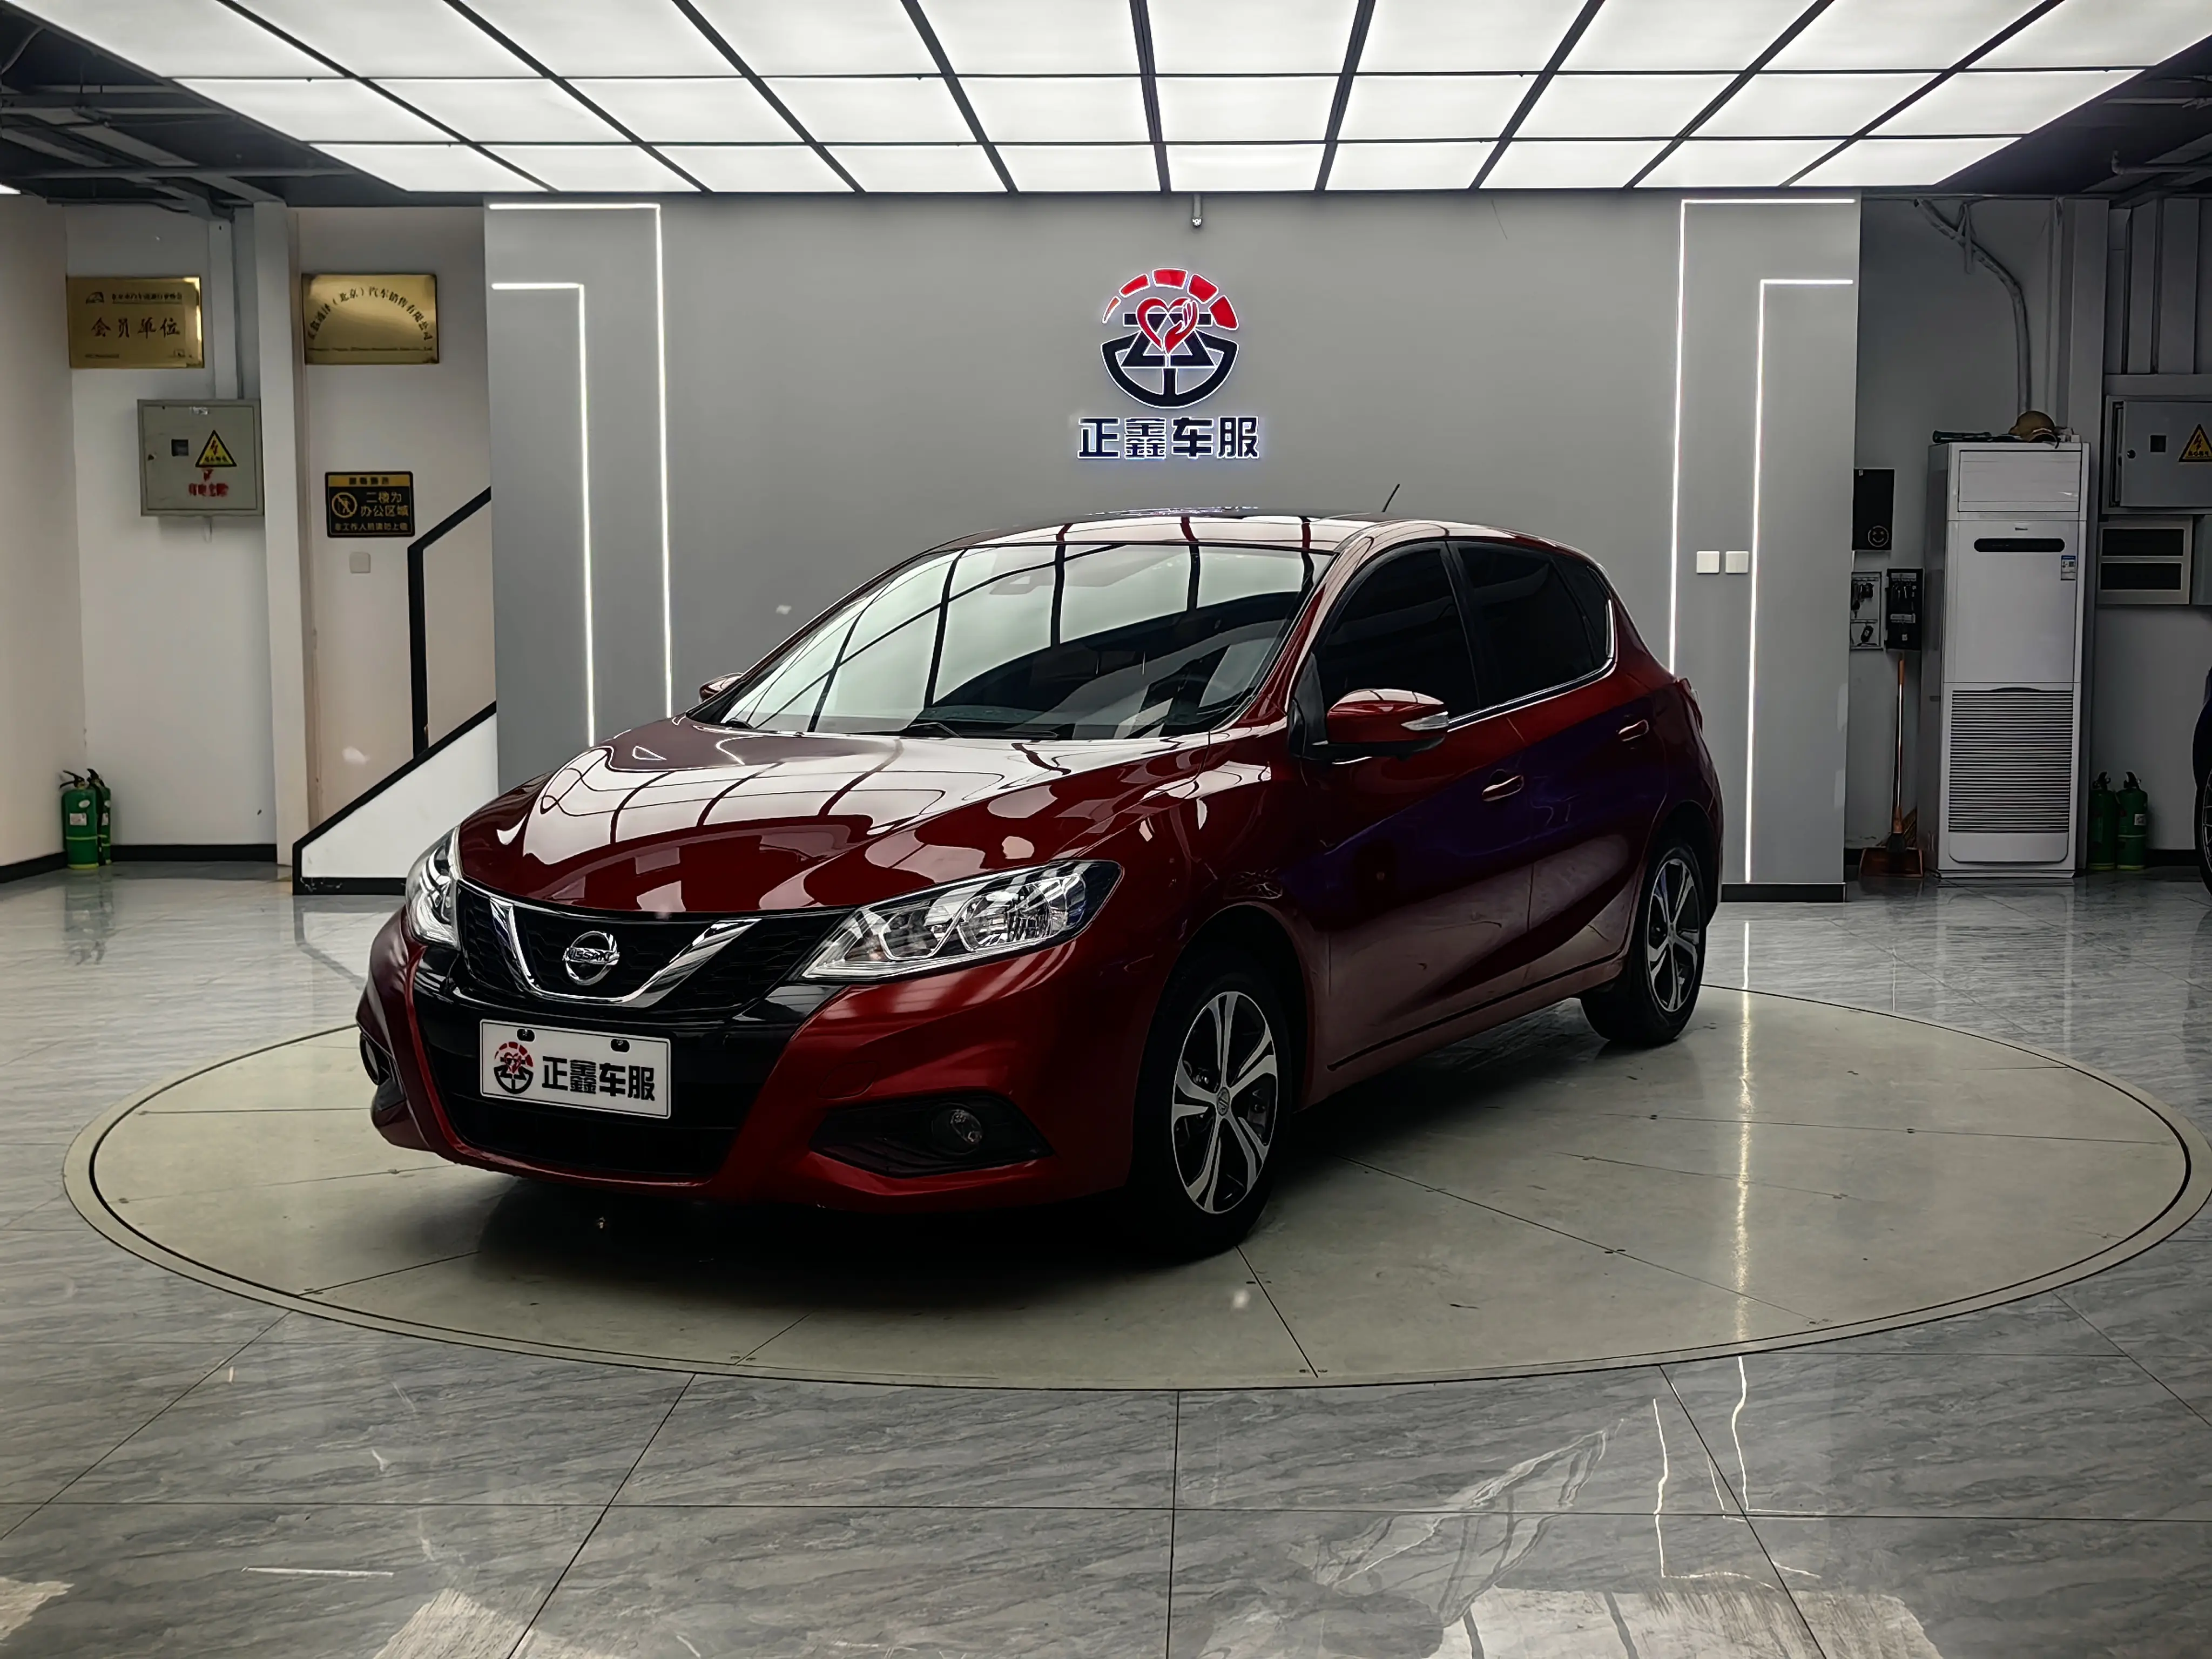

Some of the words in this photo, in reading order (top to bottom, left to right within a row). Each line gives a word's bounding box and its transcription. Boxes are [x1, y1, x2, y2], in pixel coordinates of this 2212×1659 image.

[91, 317, 181, 339] 会员单位
[1077, 416, 1262, 459] 正鑫车服
[360, 505, 409, 517] 办公区域
[569, 948, 611, 962] NISSAN
[542, 1056, 655, 1101] 正鑫车服
